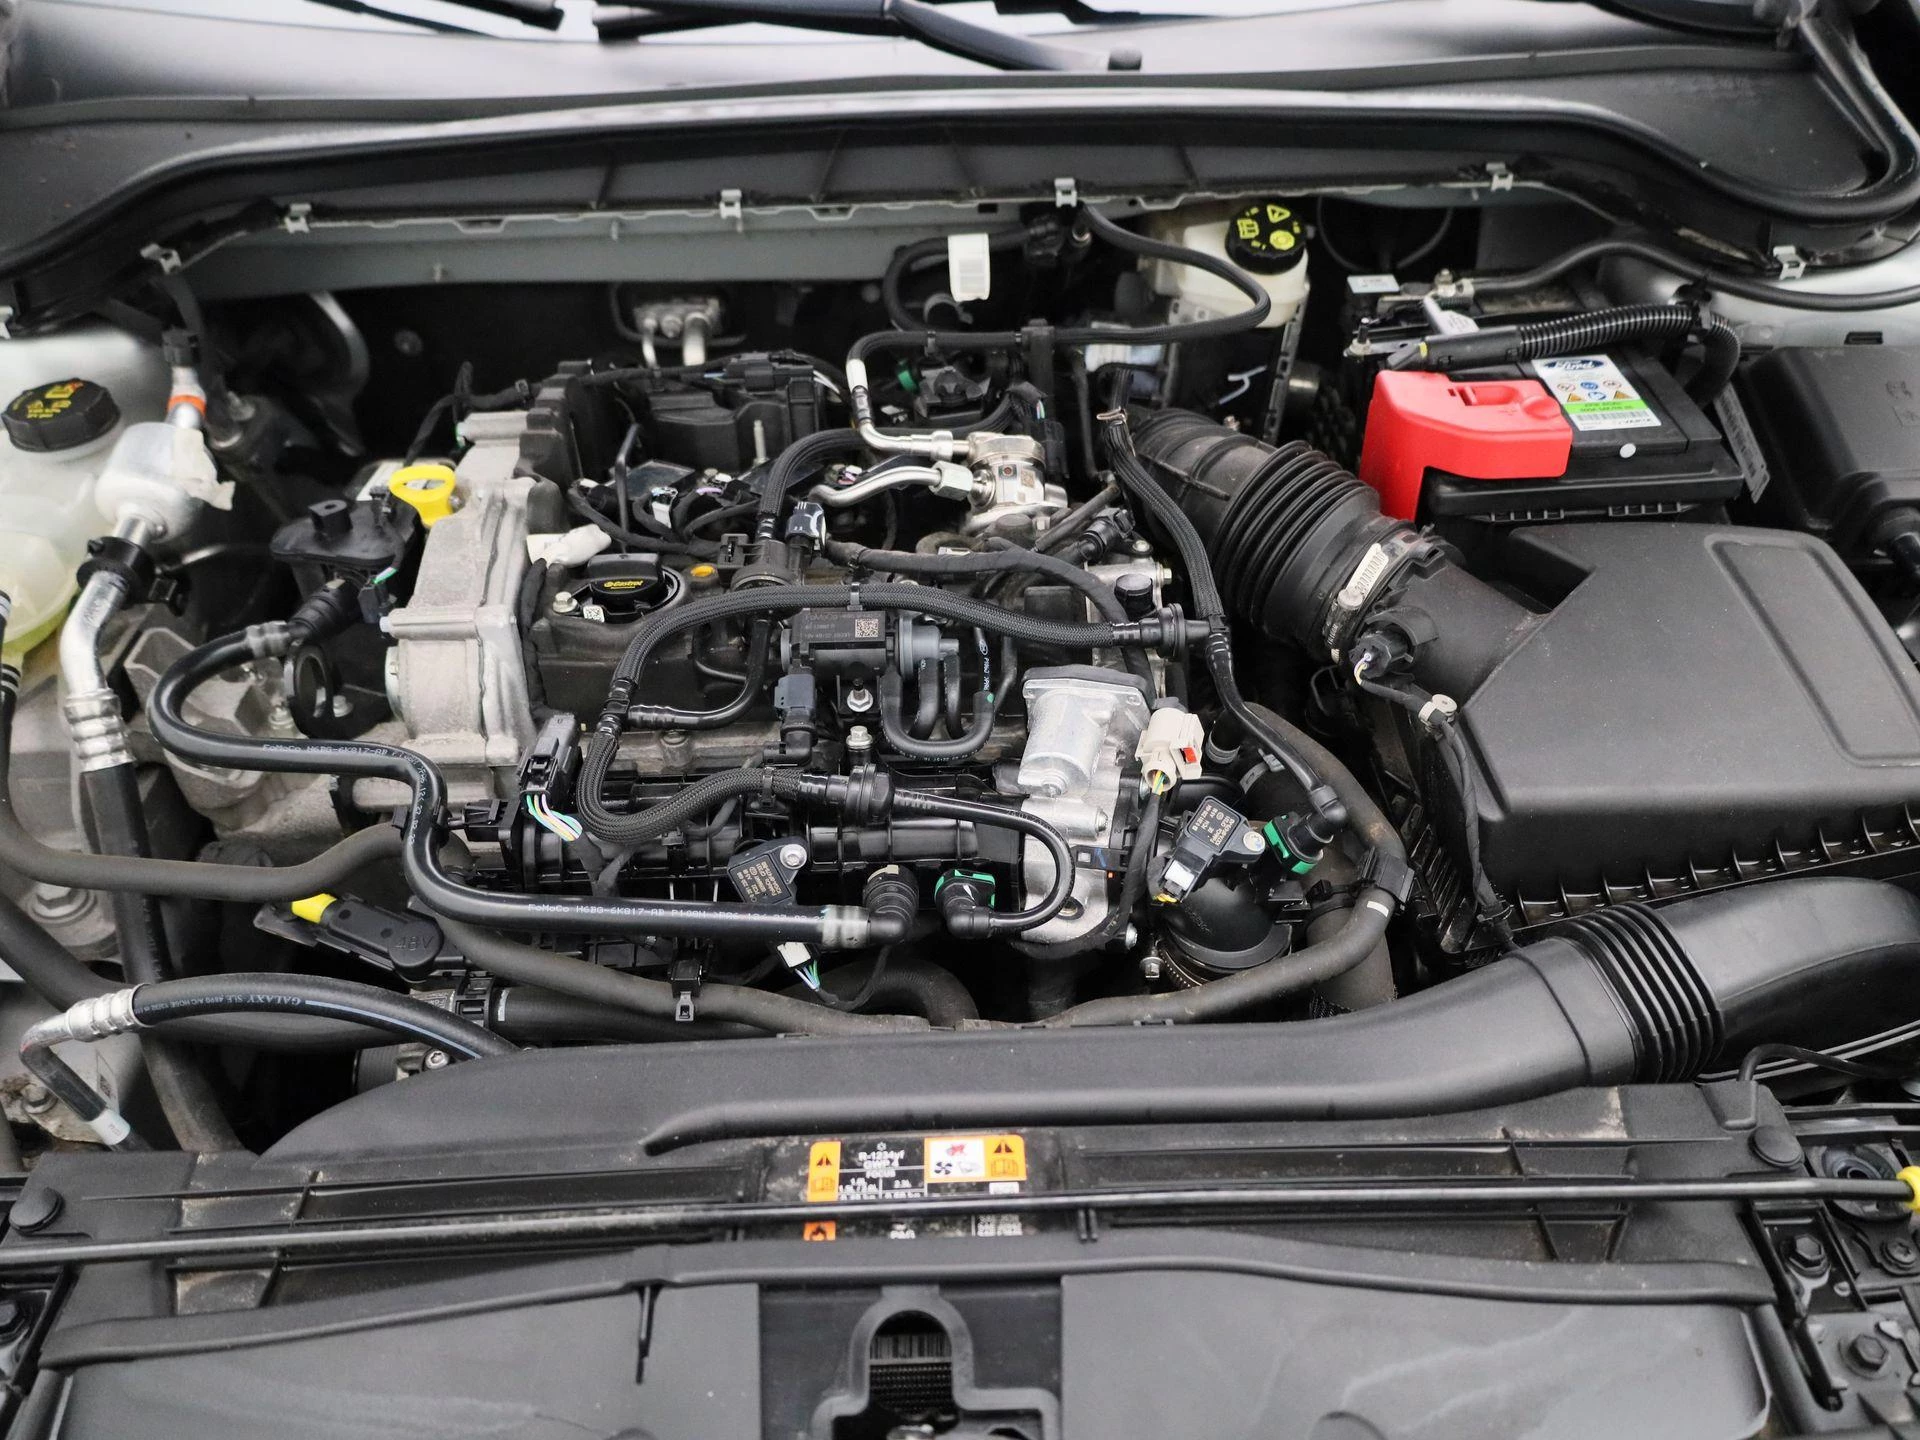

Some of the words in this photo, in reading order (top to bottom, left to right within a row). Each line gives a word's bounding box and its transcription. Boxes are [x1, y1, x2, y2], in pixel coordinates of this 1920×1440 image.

[527, 903, 570, 913] FoMoCo
[391, 935, 434, 952] 48V
[246, 993, 301, 1006] GALAXY
